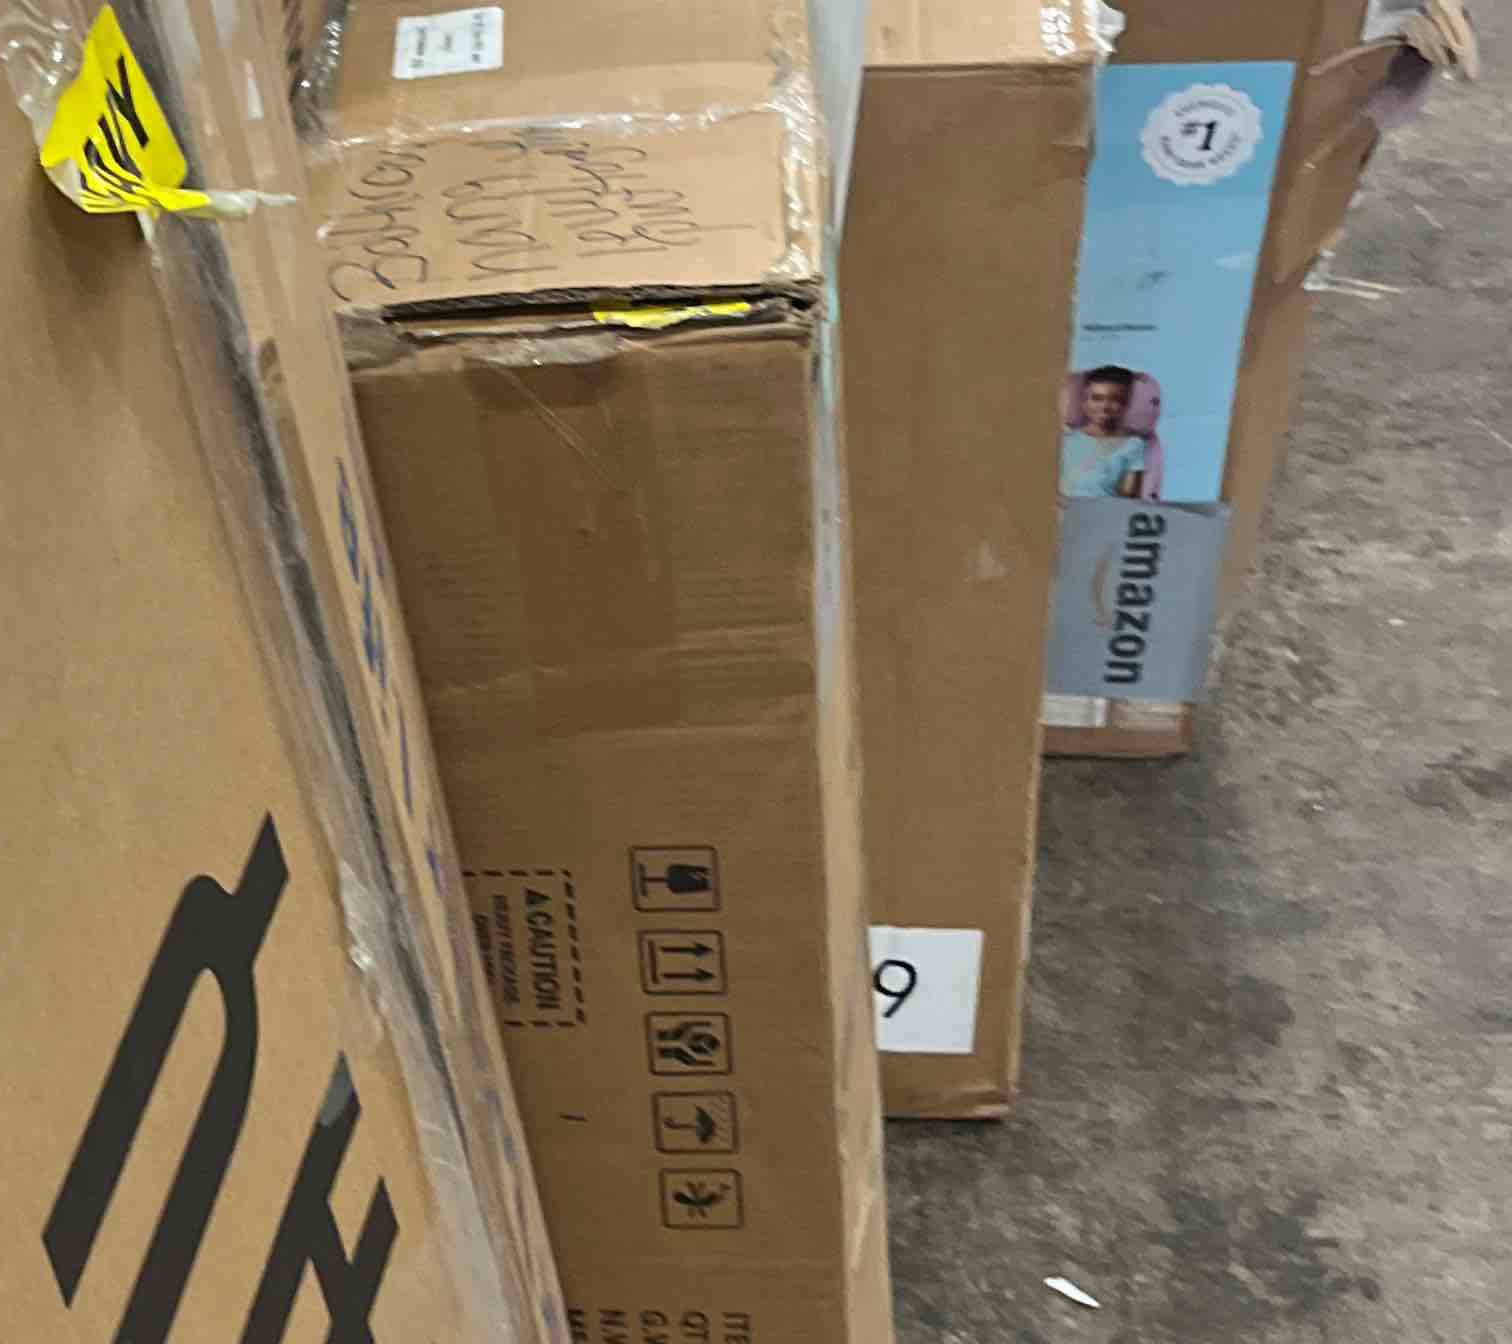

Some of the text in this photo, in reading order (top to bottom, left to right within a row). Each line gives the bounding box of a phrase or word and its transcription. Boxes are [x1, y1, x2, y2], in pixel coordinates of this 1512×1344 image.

[1102, 511, 1168, 686] amazon
[527, 910, 562, 1010] CAUTION
[872, 957, 919, 1019] 9
